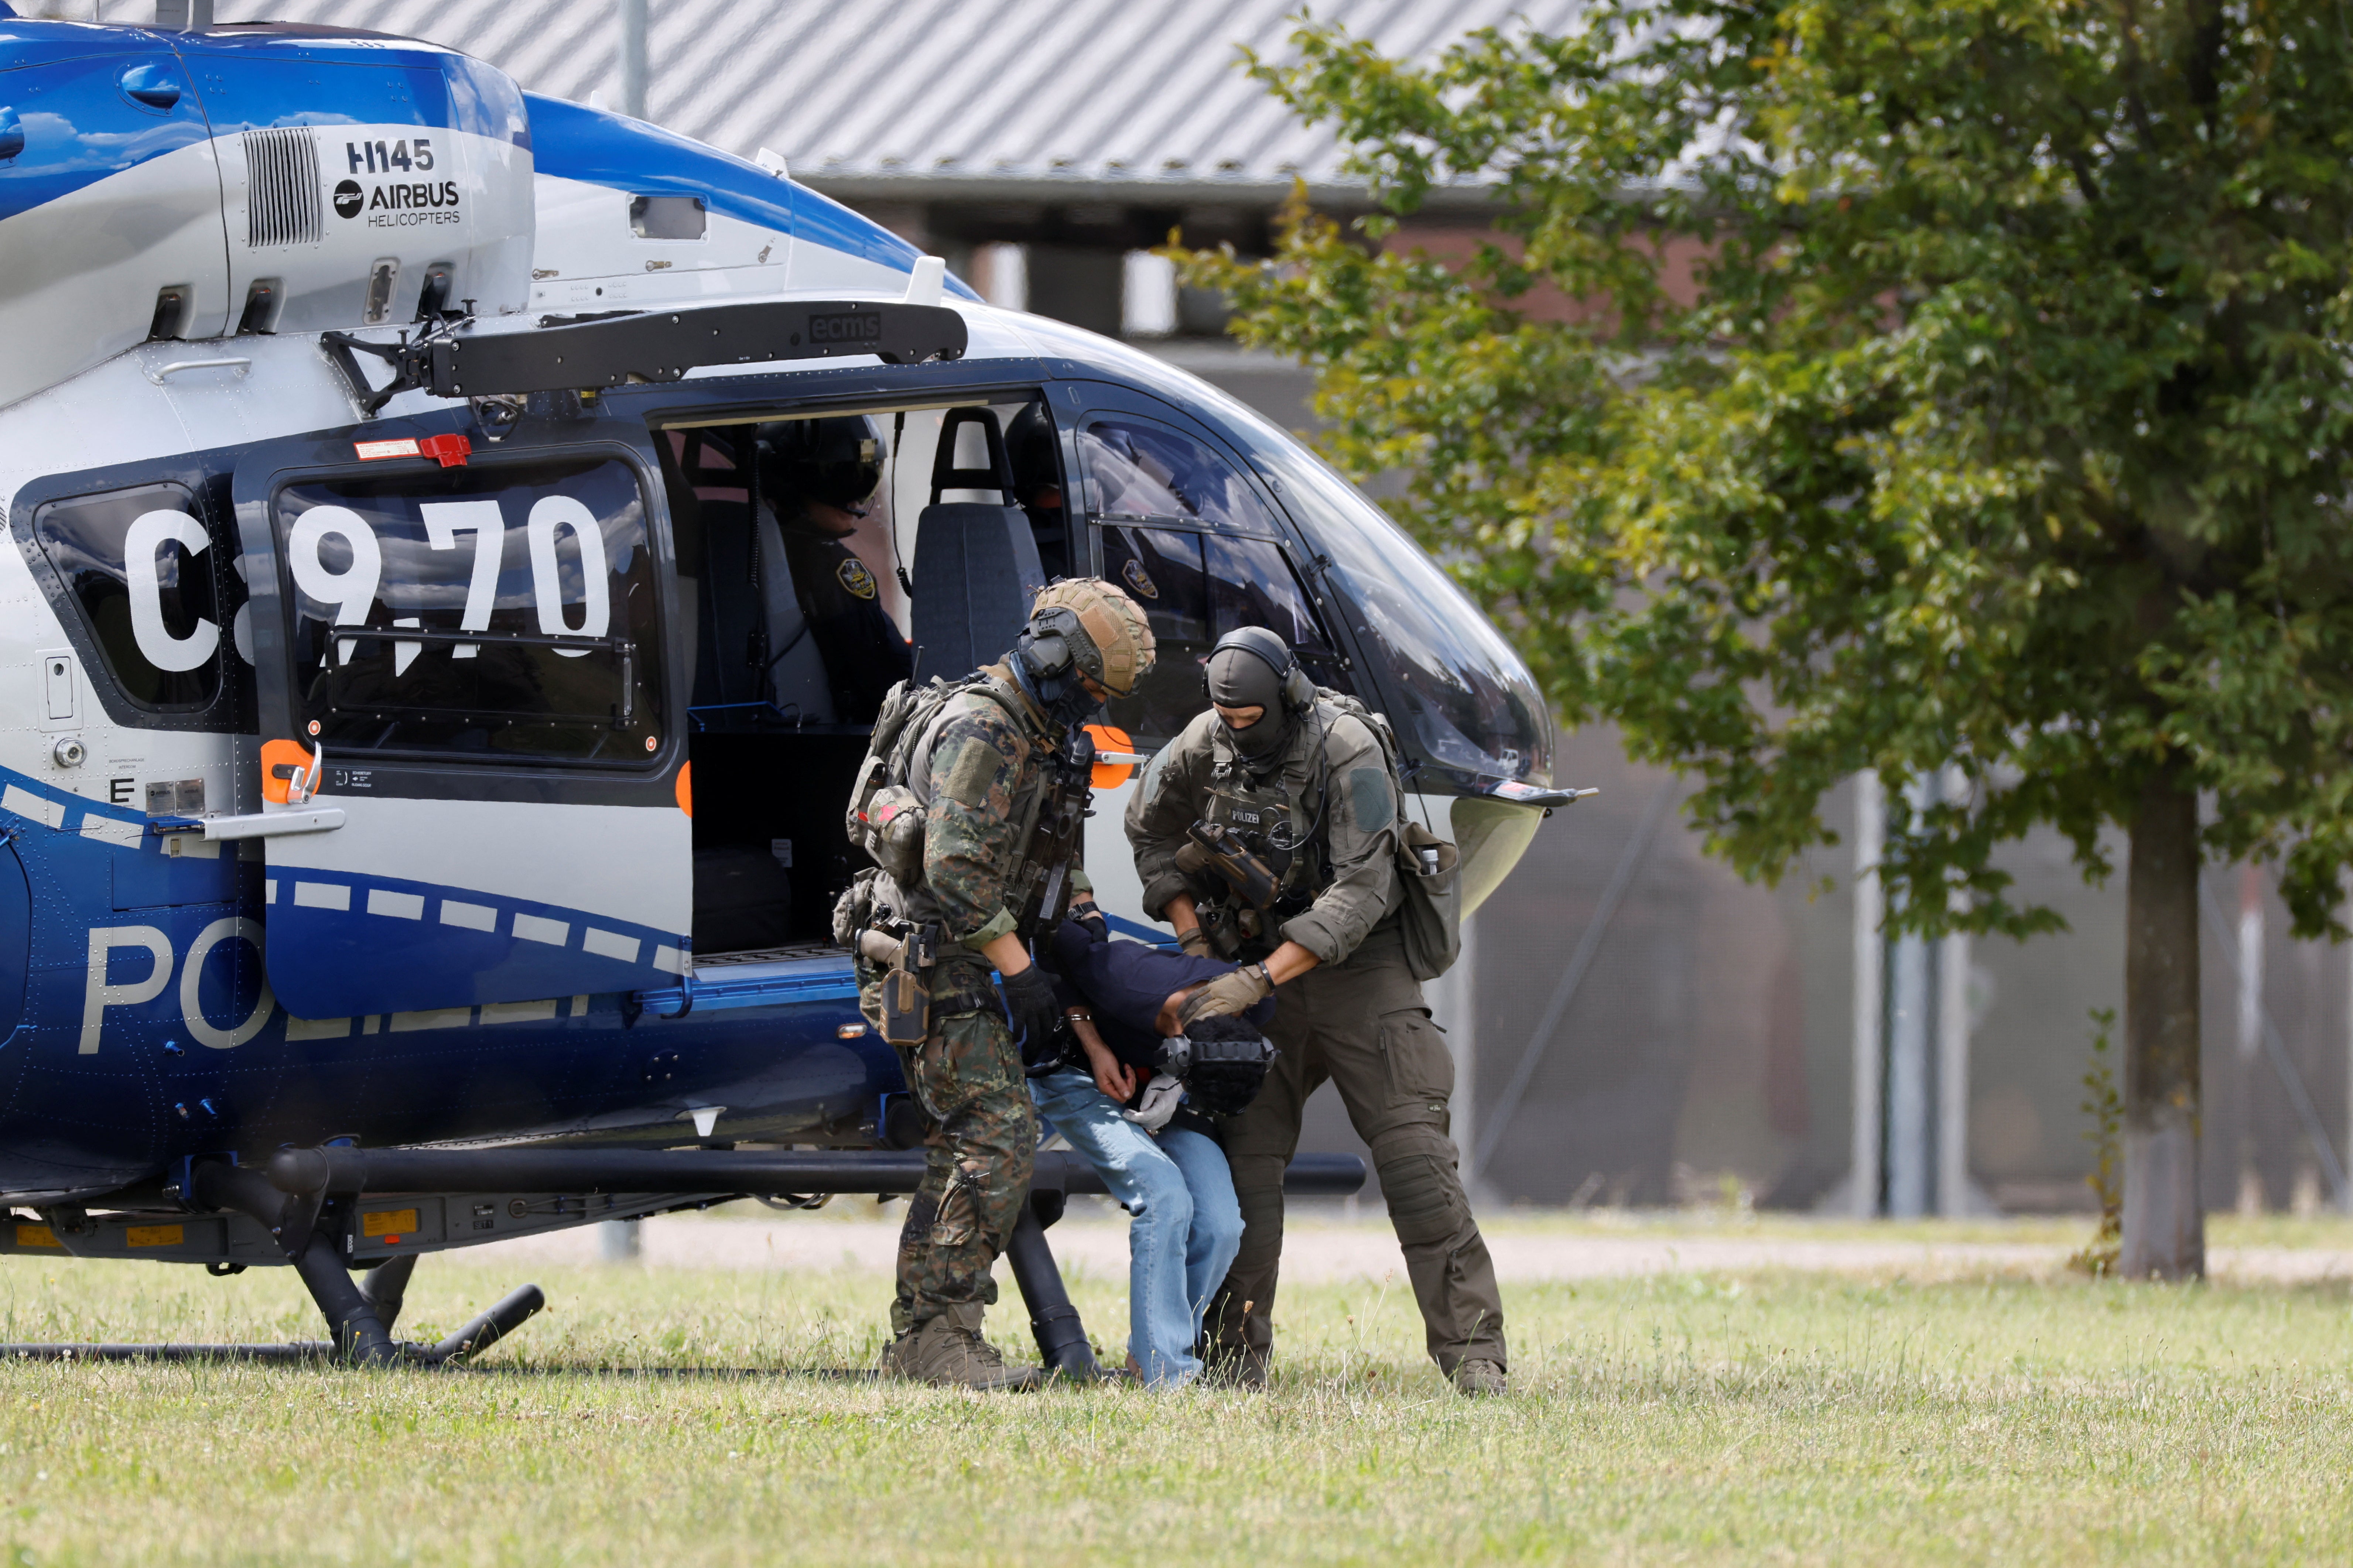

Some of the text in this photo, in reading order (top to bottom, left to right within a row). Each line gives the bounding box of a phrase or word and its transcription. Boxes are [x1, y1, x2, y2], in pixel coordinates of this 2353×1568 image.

[346, 139, 434, 174] H145
[369, 181, 459, 211] AIRBUS
[368, 211, 460, 227] HELICOPTERS
[812, 316, 879, 339] ecms
[110, 778, 134, 803] E
[1232, 810, 1259, 824] POLIZEI
